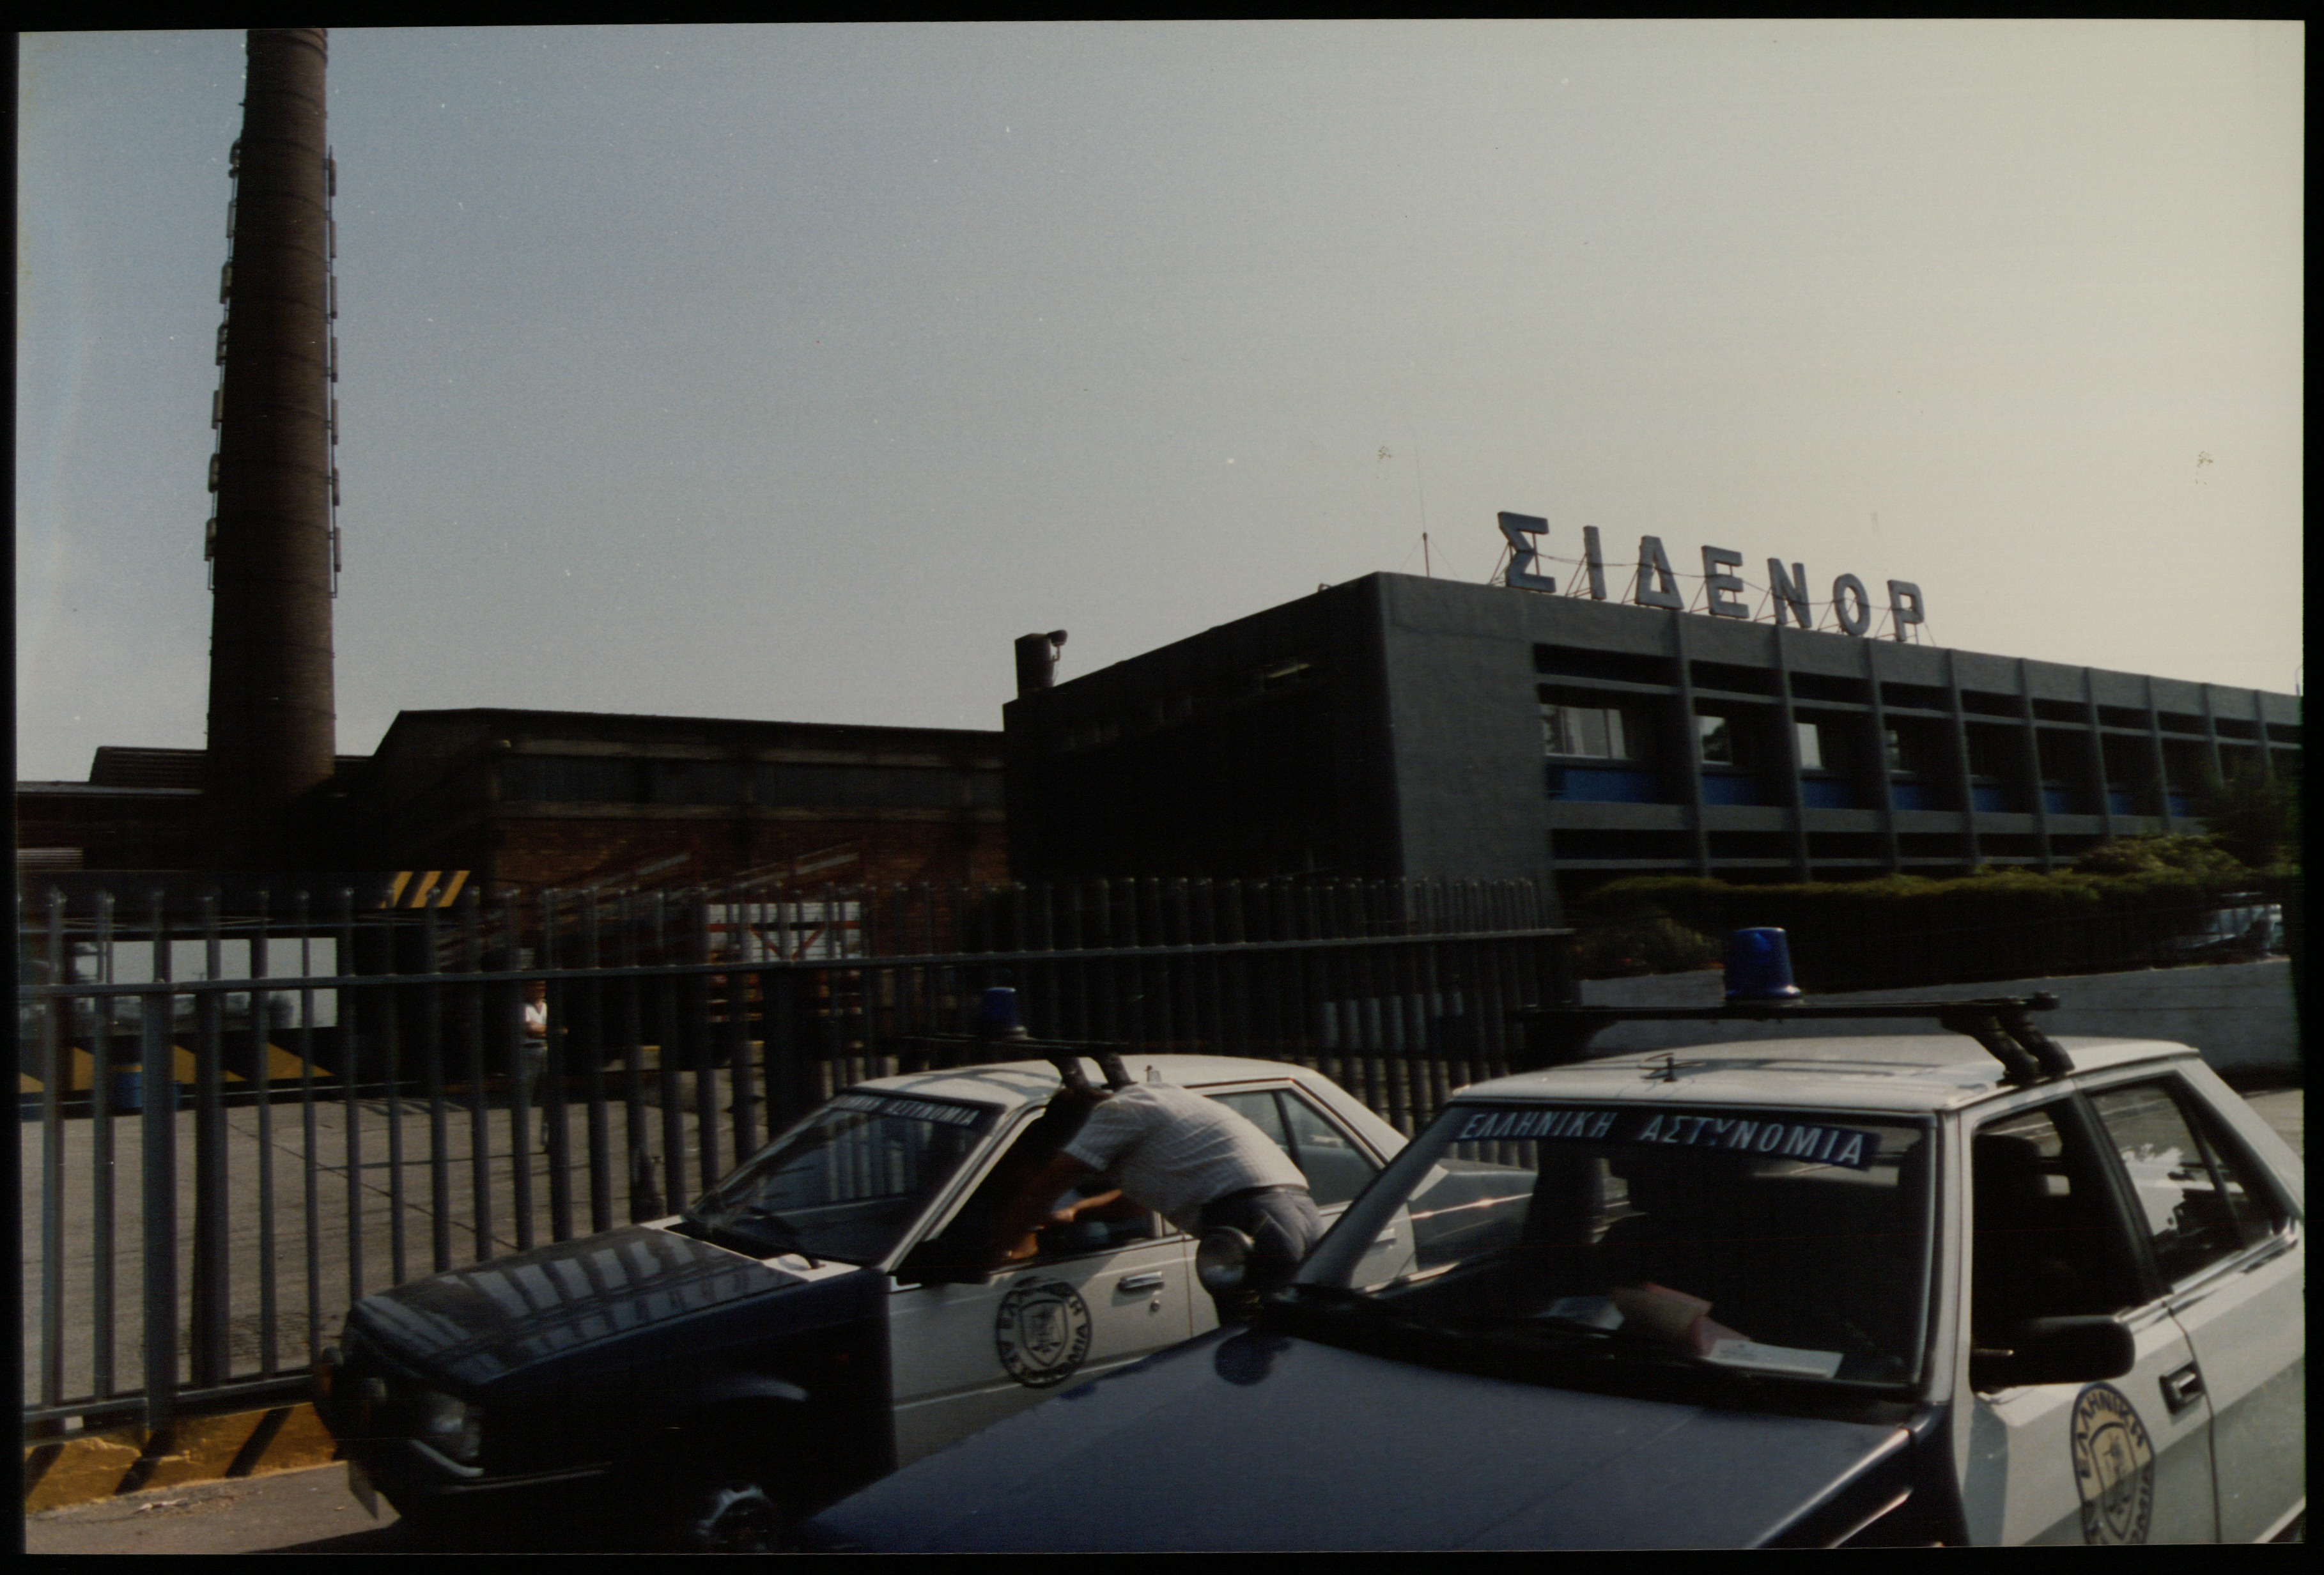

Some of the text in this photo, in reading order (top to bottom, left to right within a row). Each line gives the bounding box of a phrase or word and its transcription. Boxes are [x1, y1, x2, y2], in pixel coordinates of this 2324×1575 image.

[1498, 512, 1925, 642] ΣΙΔΕΝΟΡ
[1458, 1110, 1864, 1165] ΕΛΛΗΝΙΚΗ ΑΣΤΥΝΟΜΙΑ
